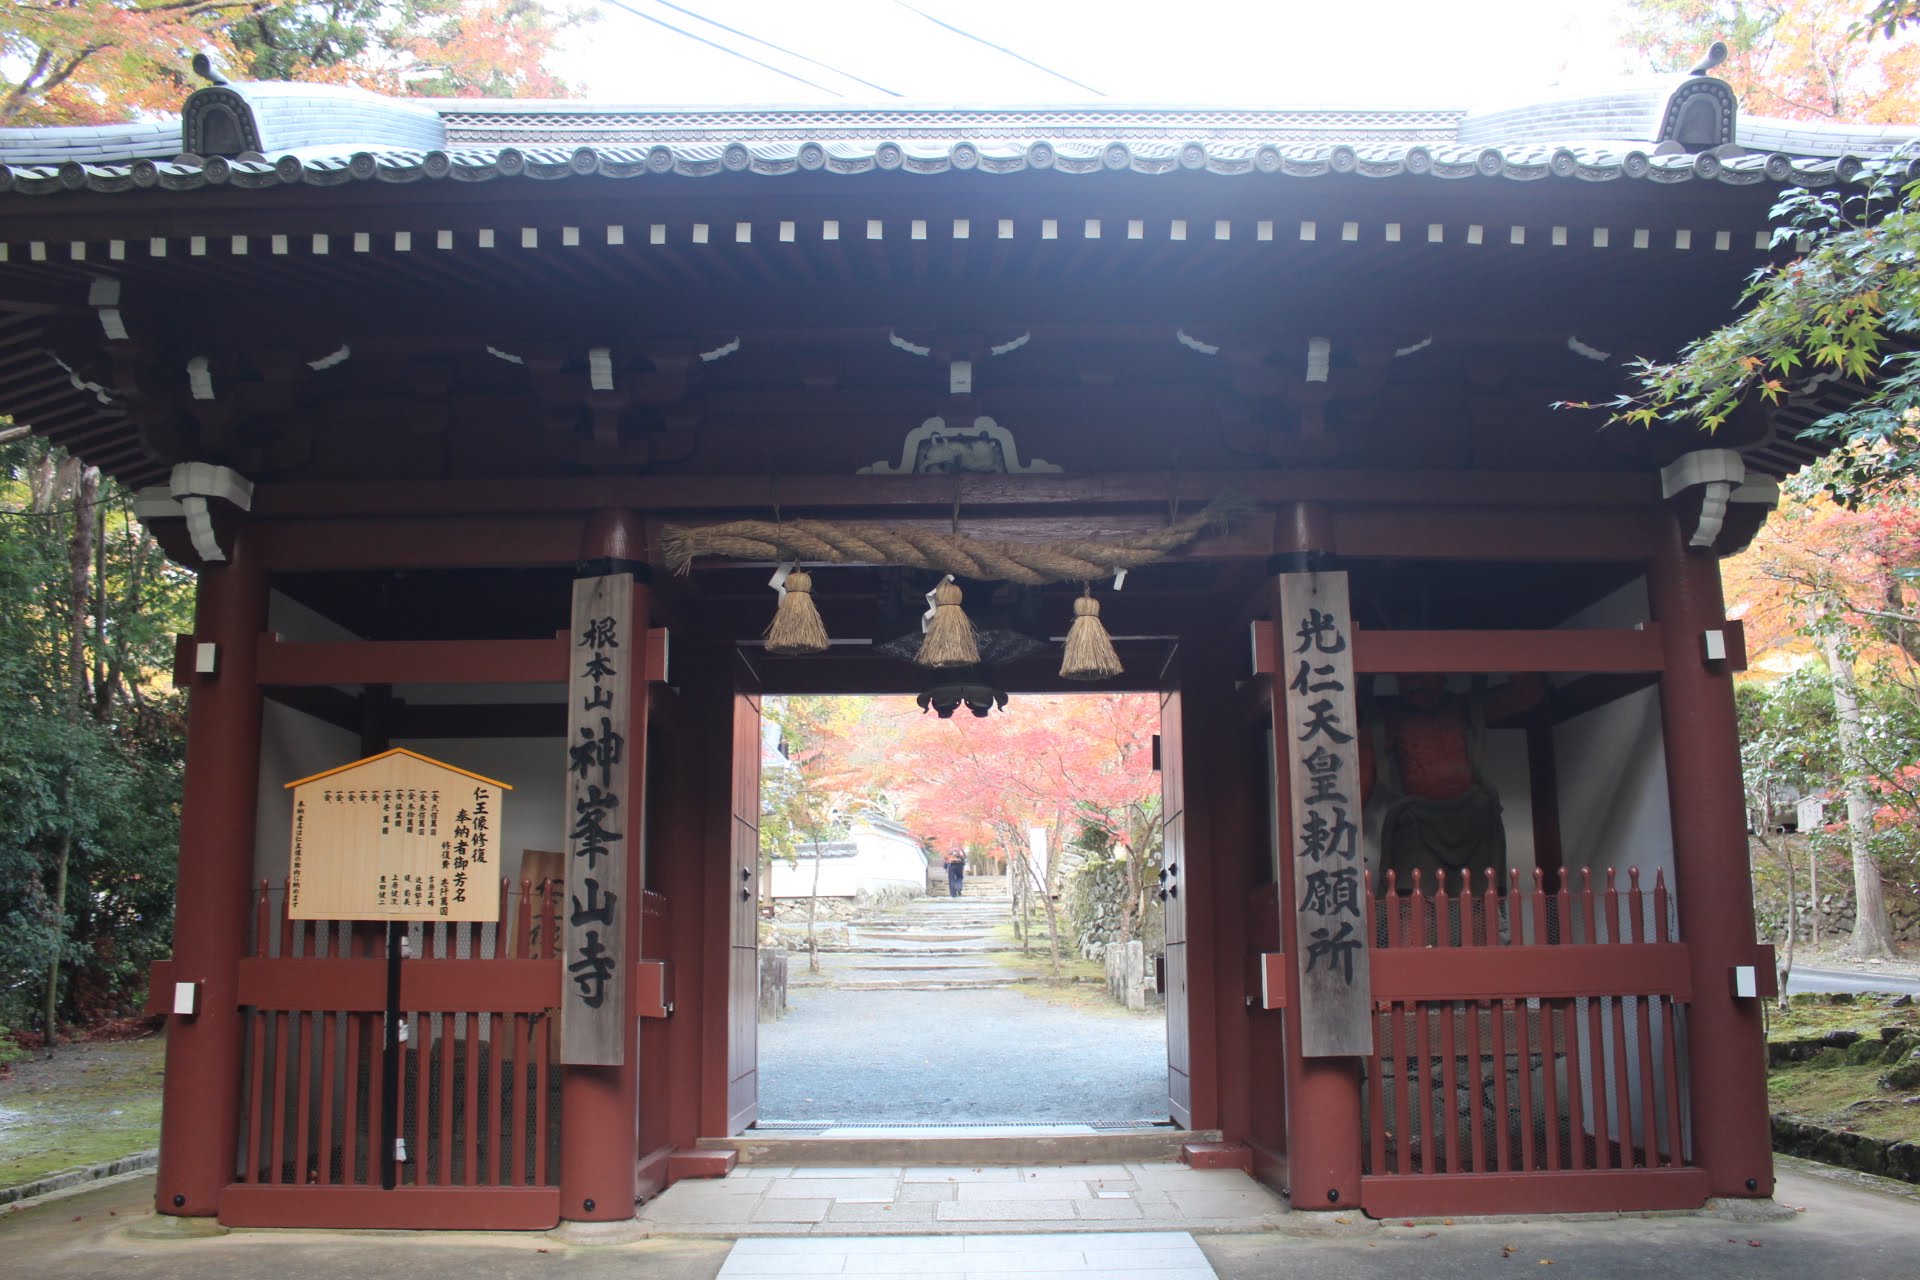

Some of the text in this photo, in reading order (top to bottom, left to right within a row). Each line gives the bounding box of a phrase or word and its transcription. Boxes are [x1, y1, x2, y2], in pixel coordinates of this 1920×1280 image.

[471, 787, 489, 864] 仁王像修復
[1290, 608, 1363, 986] 光仁天皇勅願所
[441, 841, 451, 869] 修復費
[453, 808, 472, 903] 奉納者御芳名
